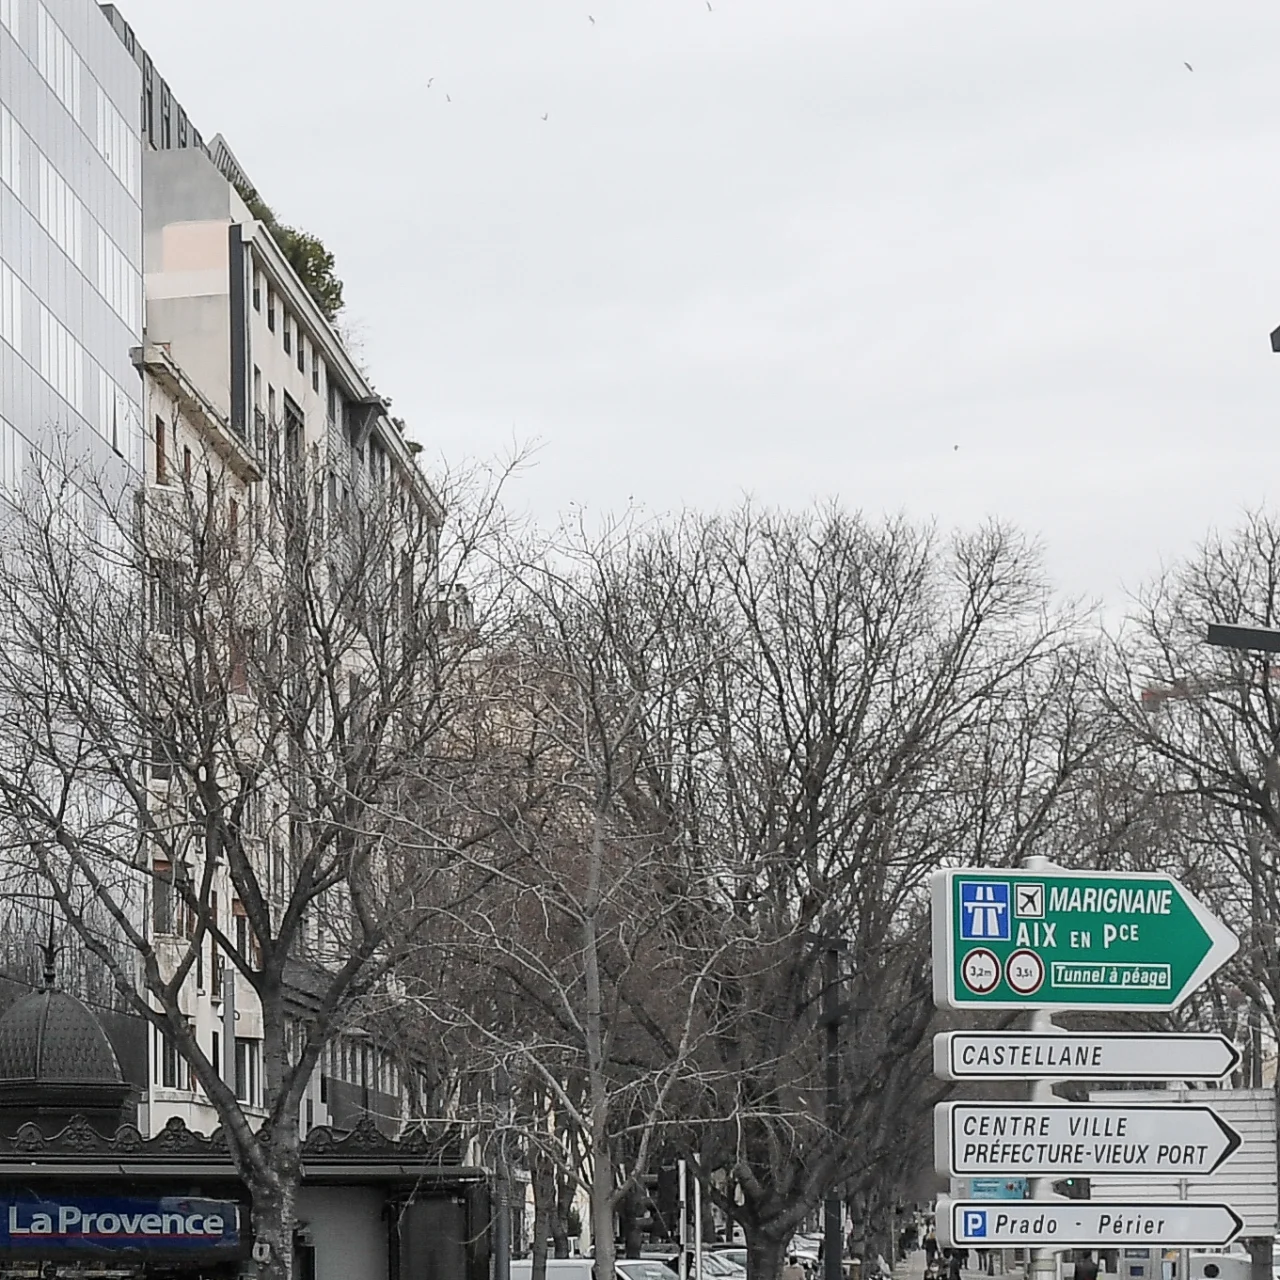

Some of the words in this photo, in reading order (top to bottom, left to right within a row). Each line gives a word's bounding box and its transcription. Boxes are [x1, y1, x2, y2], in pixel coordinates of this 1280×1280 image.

[1048, 887, 1172, 914] MARIGNANE
[1016, 922, 1057, 948] AIX
[1070, 931, 1090, 948] EN
[970, 966, 992, 977] 3,2m
[1055, 966, 1105, 983] Tunnel
[1109, 967, 1118, 983] à
[1122, 967, 1167, 987] péage
[962, 1045, 1103, 1066] CASTELLANE
[963, 1116, 1051, 1137] CENTRE
[1068, 1117, 1127, 1137] VILLE
[1156, 1145, 1208, 1165] PORT
[8, 1206, 52, 1234] La
[58, 1206, 224, 1235] Provence
[968, 1213, 983, 1233] P
[995, 1214, 1057, 1234] Prado
[1098, 1214, 1165, 1234] Périer
